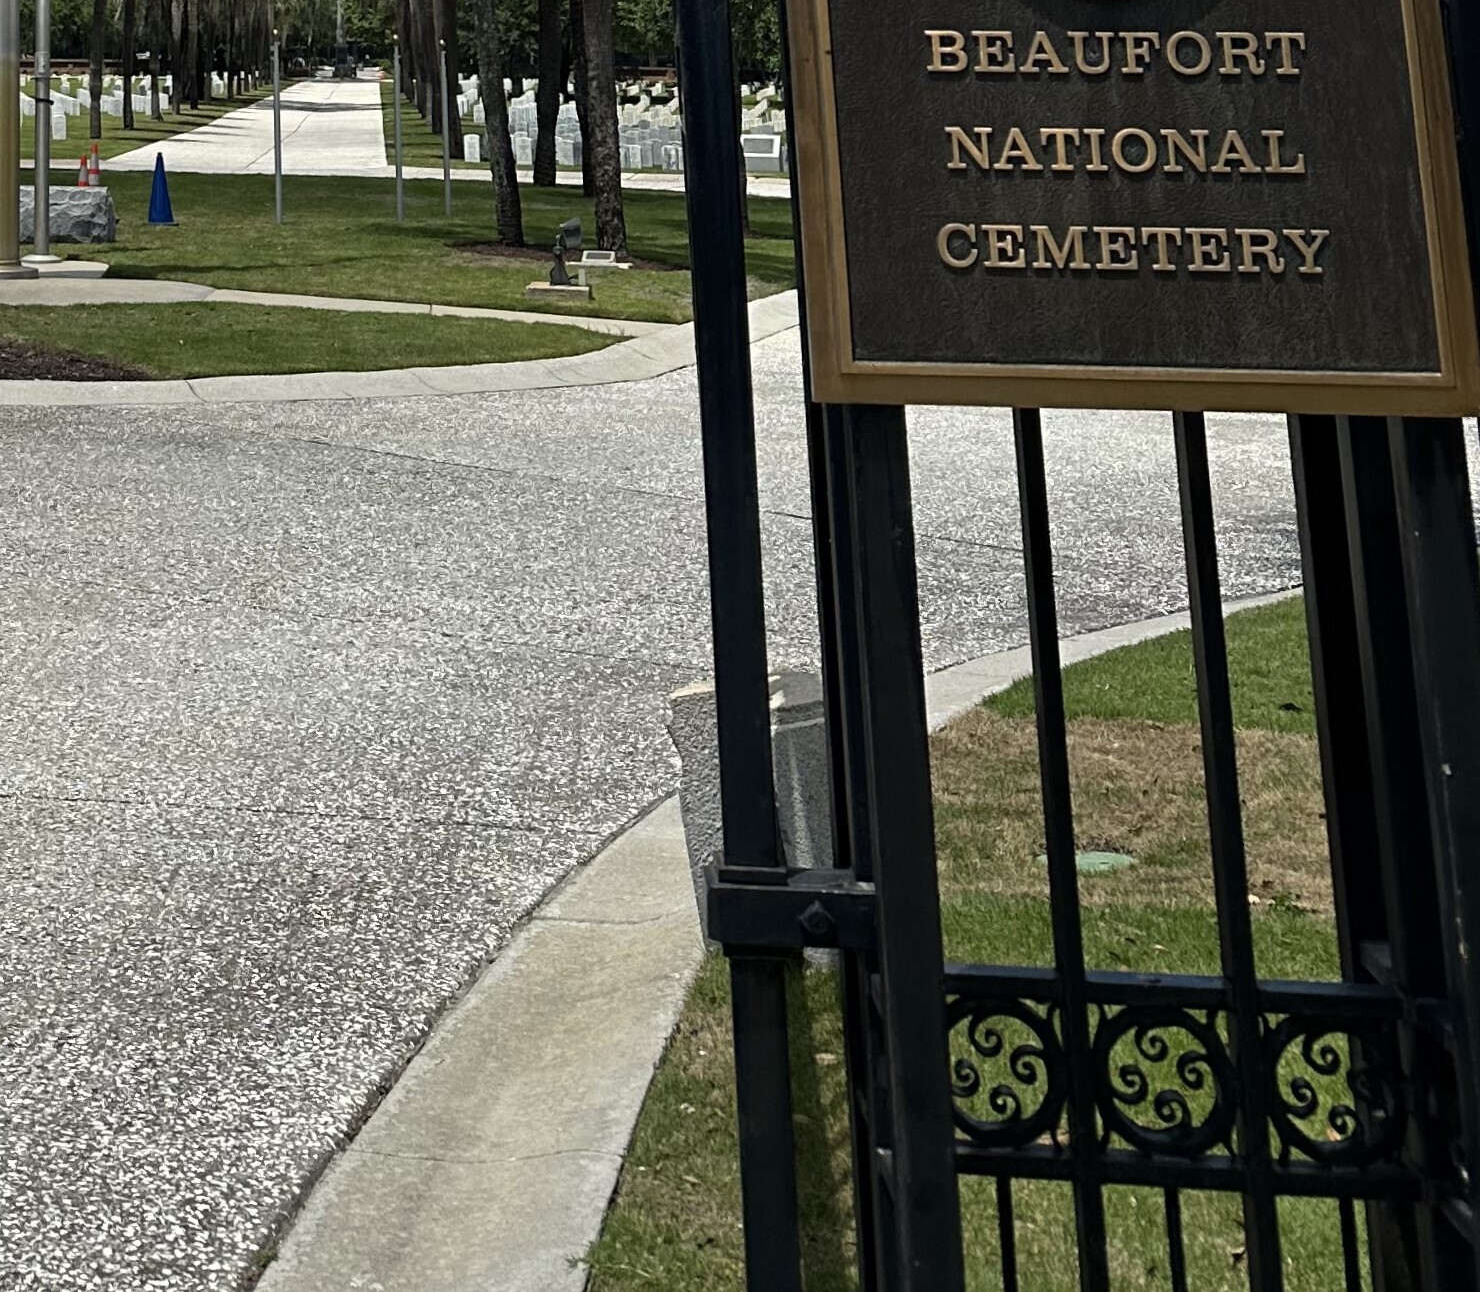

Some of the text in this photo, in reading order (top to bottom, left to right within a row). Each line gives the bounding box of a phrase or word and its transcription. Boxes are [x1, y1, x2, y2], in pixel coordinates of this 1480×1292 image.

[923, 29, 1307, 77] BEAUFORT
[944, 125, 1307, 175] NATIONAL
[935, 222, 1330, 275] CEMETERY
